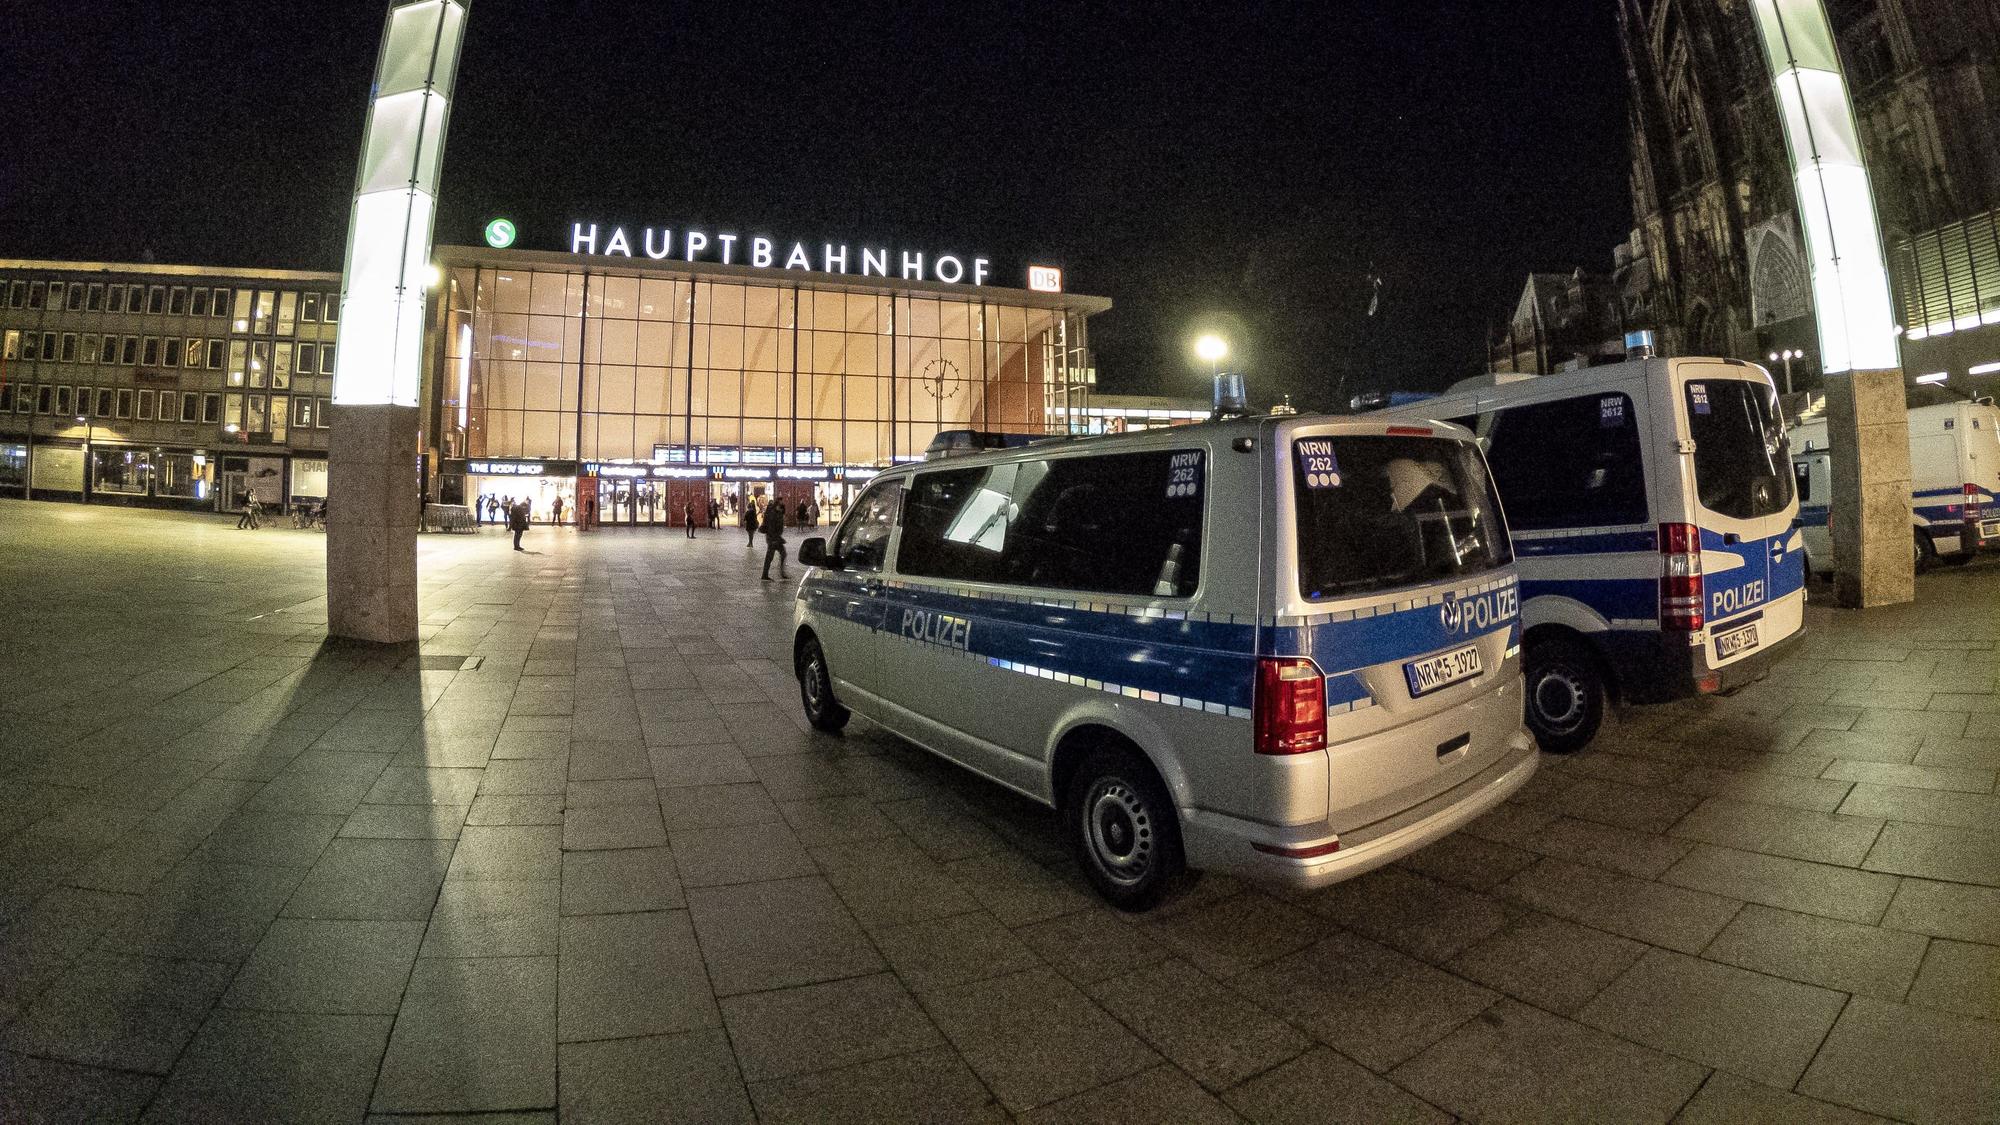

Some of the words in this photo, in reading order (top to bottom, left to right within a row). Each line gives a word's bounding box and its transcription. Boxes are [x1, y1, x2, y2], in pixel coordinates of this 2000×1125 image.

[571, 222, 989, 286] HAUPTBAHNHOF
[1032, 269, 1058, 289] DB
[1690, 384, 1706, 394] NRW
[1601, 396, 1624, 408] NRW
[1299, 441, 1332, 456] NRW
[1171, 452, 1200, 468] NRW
[1308, 457, 1333, 472] 262
[470, 463, 489, 474] THE
[489, 463, 517, 474] BODY
[517, 464, 543, 475] SHOP
[1173, 468, 1195, 483] 262
[1713, 578, 1764, 617] POLIZEI
[1463, 586, 1519, 634] POLIZEI
[901, 608, 972, 651] POLIZEI
